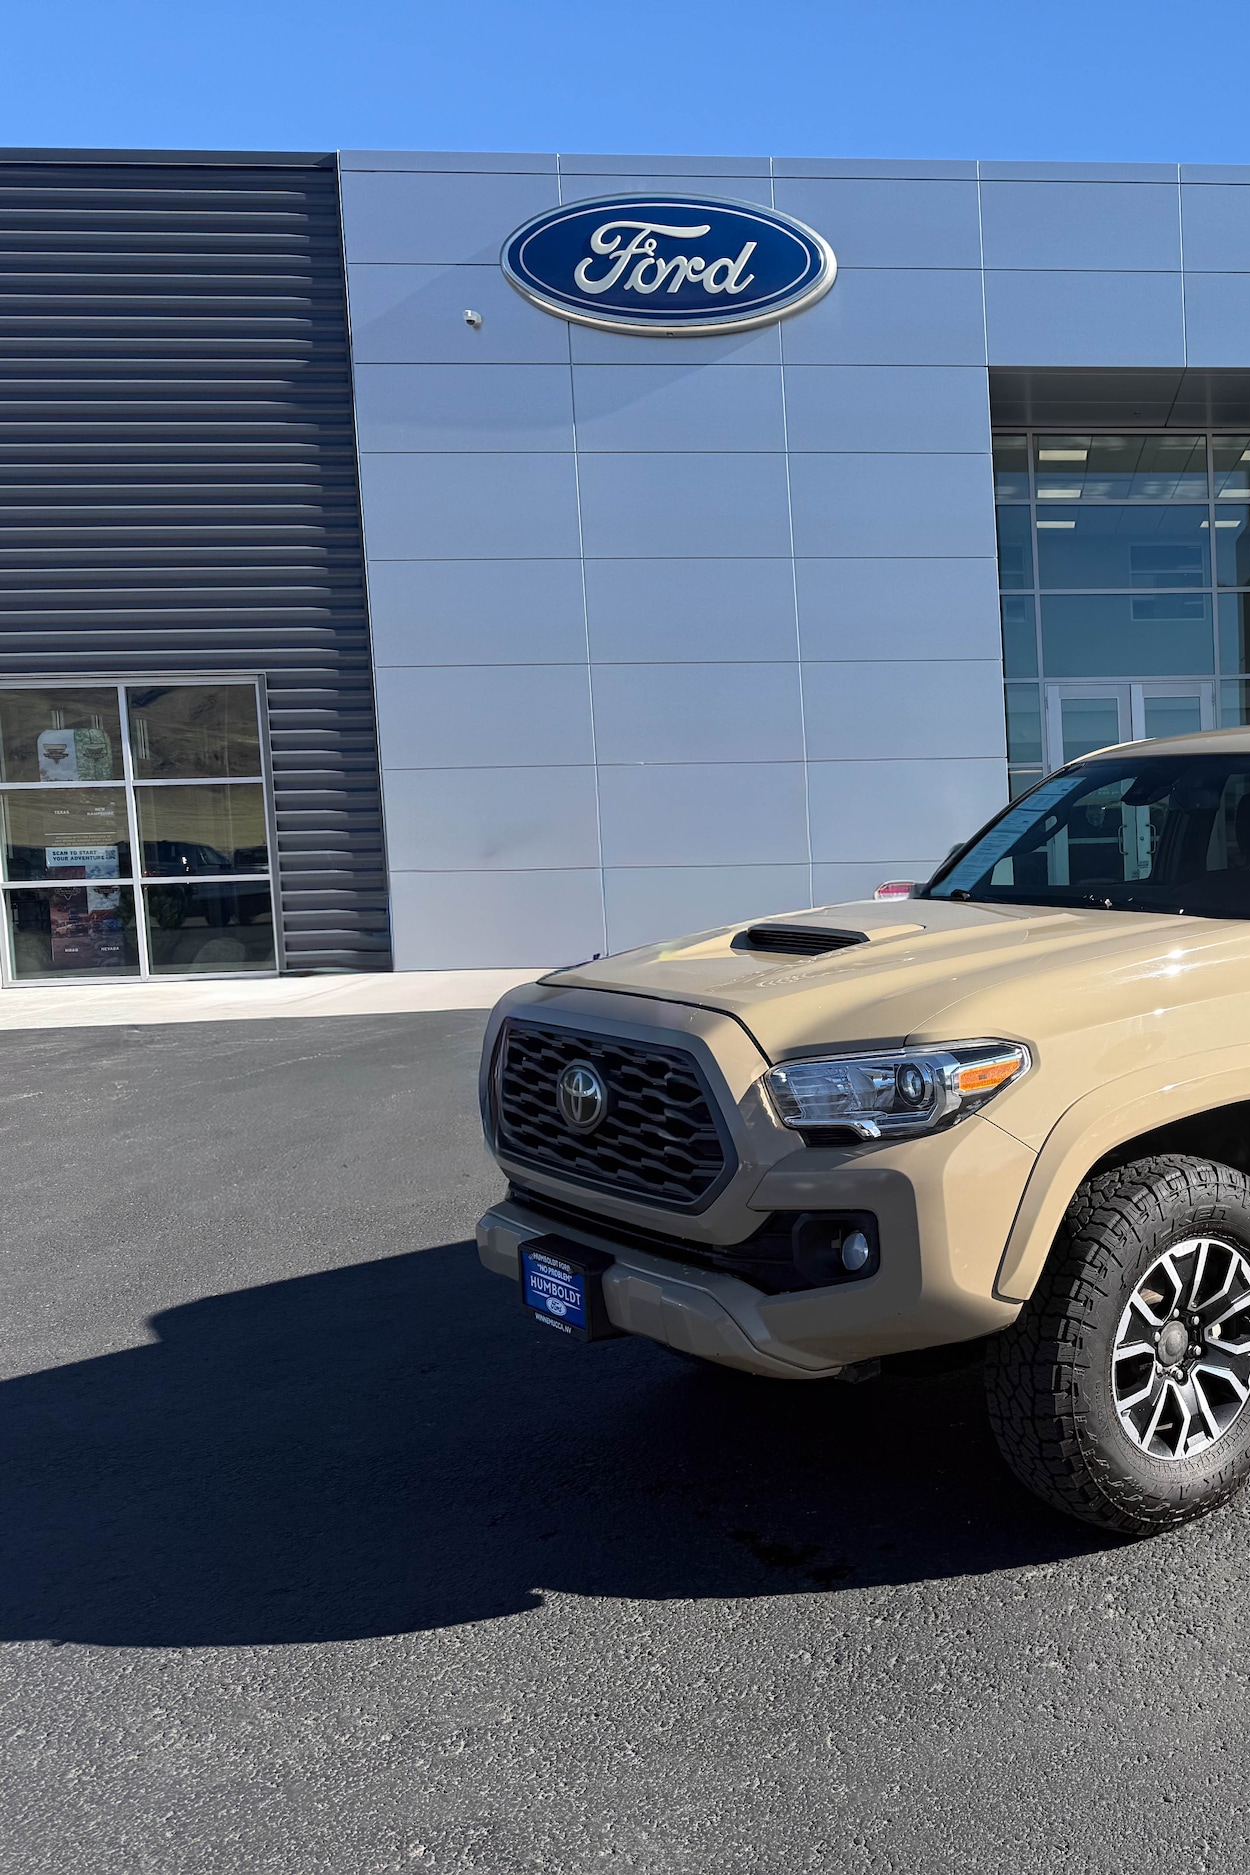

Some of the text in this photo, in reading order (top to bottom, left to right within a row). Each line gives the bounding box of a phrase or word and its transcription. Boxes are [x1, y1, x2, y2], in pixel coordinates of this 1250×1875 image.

[574, 220, 757, 295] Ford
[533, 1252, 558, 1267] HUMBOLDT
[530, 1275, 581, 1306] HUMBOLDT
